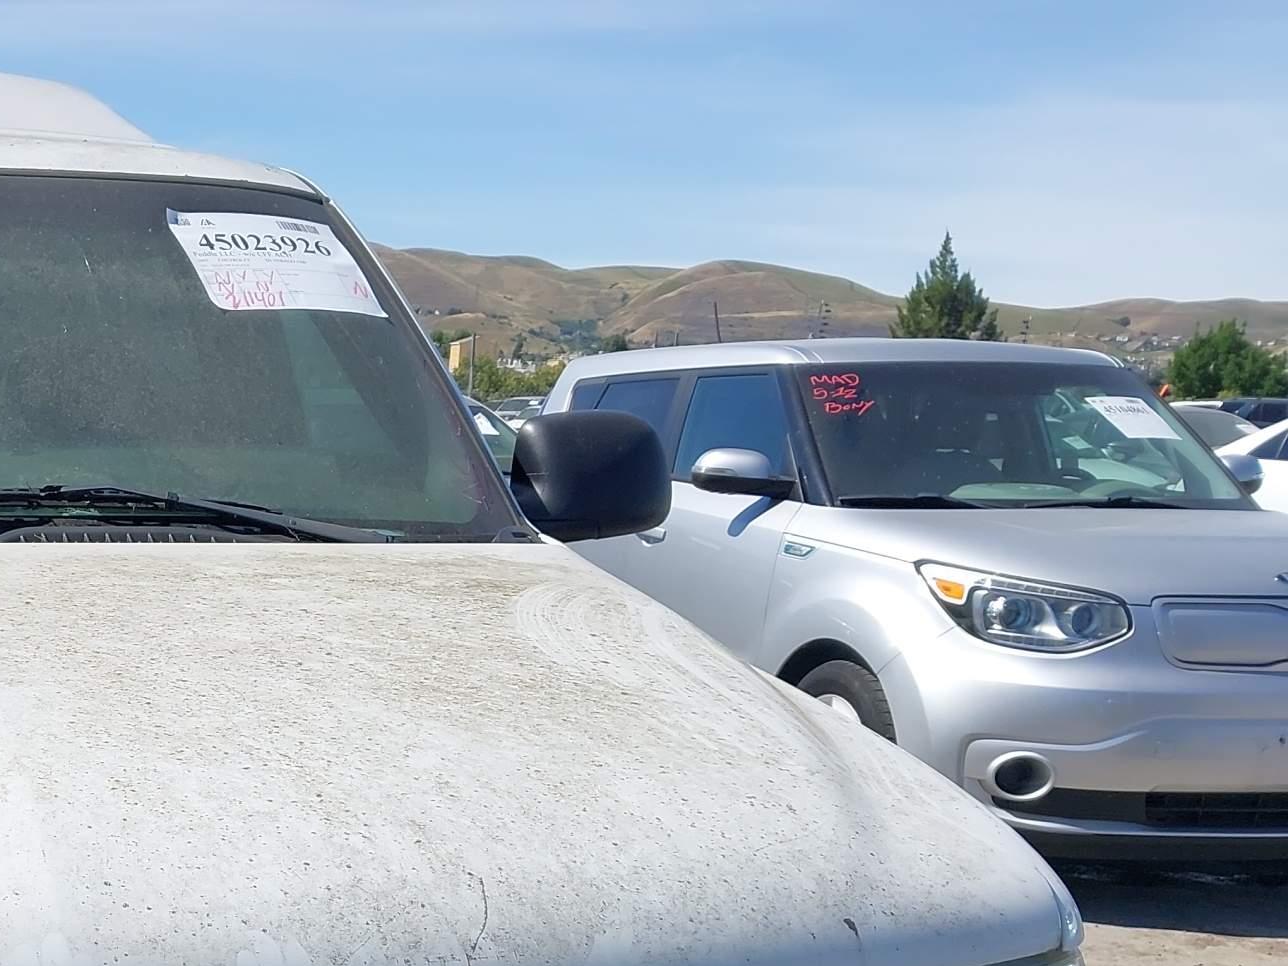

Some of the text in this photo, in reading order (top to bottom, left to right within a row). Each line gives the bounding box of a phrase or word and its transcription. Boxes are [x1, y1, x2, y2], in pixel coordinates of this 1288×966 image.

[198, 233, 332, 257] 45023926
[810, 373, 860, 386] MAD
[813, 387, 858, 400] 5-12
